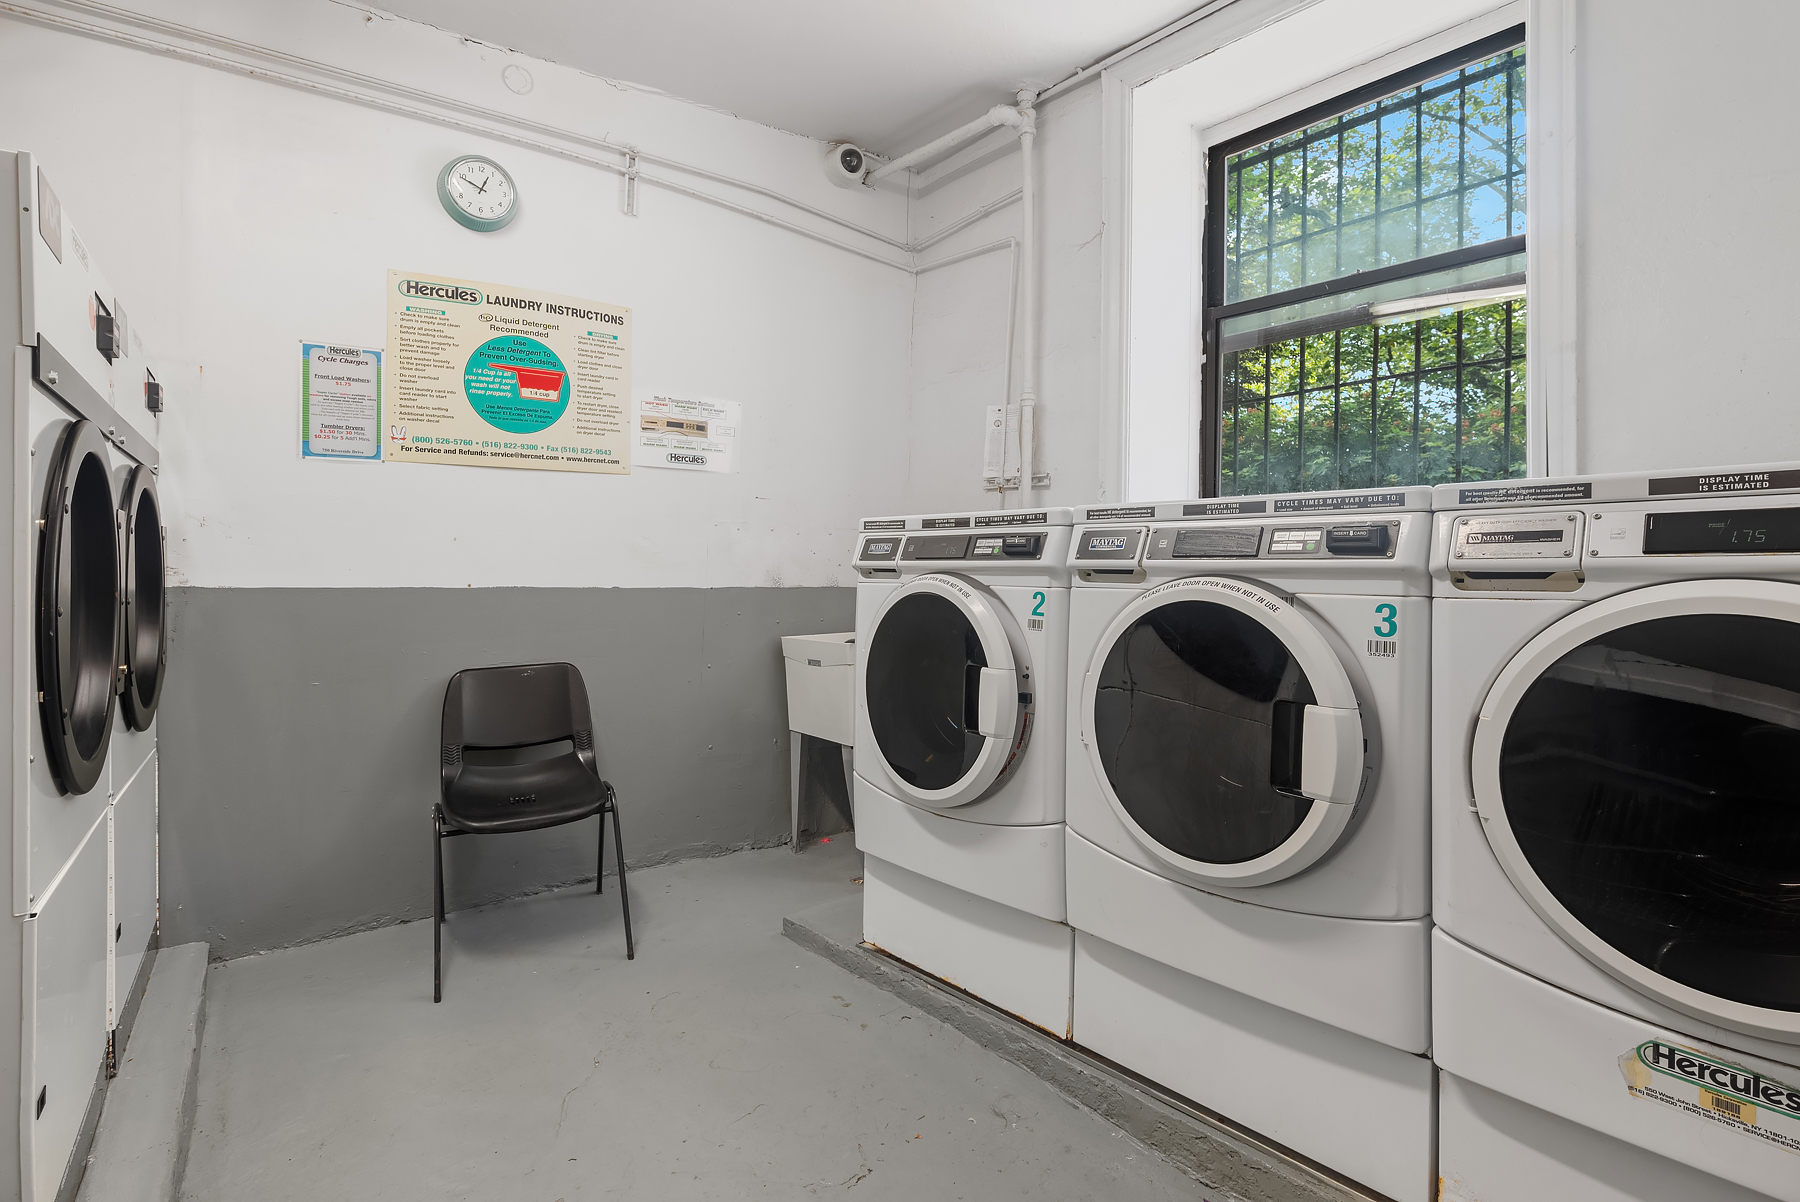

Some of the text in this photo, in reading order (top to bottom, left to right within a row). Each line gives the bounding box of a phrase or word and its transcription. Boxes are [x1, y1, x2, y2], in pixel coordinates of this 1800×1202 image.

[406, 280, 624, 325] Hercules LAUNDRY INSTRUCTIONS
[495, 315, 520, 325] Liquid
[522, 319, 560, 331] Detergent
[489, 324, 549, 338] Recommended
[329, 346, 359, 356] Hercules
[507, 347, 541, 357] Detergent
[318, 355, 368, 366] Cycle Charges
[480, 352, 558, 367] Prevent Over-Sudsing.
[412, 436, 433, 444] (800)
[435, 437, 473, 446] 526-5760
[482, 440, 501, 449] (516)
[504, 442, 538, 450] 822-9300
[561, 446, 578, 454] (516)
[580, 447, 612, 455] 822-9543
[490, 451, 559, 461] service@hercnet.com
[566, 455, 620, 465] www.hercnet.com
[670, 454, 704, 464] Hercules
[1699, 475, 1740, 484] DISPLAY
[1713, 481, 1769, 491] ESTIMATED
[1732, 529, 1766, 543] 1.75
[938, 578, 950, 586] WHEN
[949, 582, 958, 590] NOT
[962, 590, 972, 599] USE
[1032, 592, 1046, 617] 2
[1141, 588, 1161, 600] PLEASE
[1162, 582, 1182, 591] LEAVE
[1221, 583, 1241, 593] WHEN
[1242, 589, 1257, 599] NOT
[1255, 595, 1265, 604] IN
[1265, 600, 1281, 614] USE
[1374, 603, 1397, 637] 3
[1652, 1042, 1800, 1112] Hercules
[1628, 1086, 1645, 1096] (516)
[1646, 1092, 1677, 1107] 822-9300
[1683, 1105, 1701, 1116] (800)
[1703, 1112, 1735, 1128] 526-5760
[1645, 1086, 1657, 1094] 550
[1658, 1091, 1674, 1100] West
[1692, 1103, 1712, 1114] Street
[1718, 1112, 1749, 1128] Hicksville,
